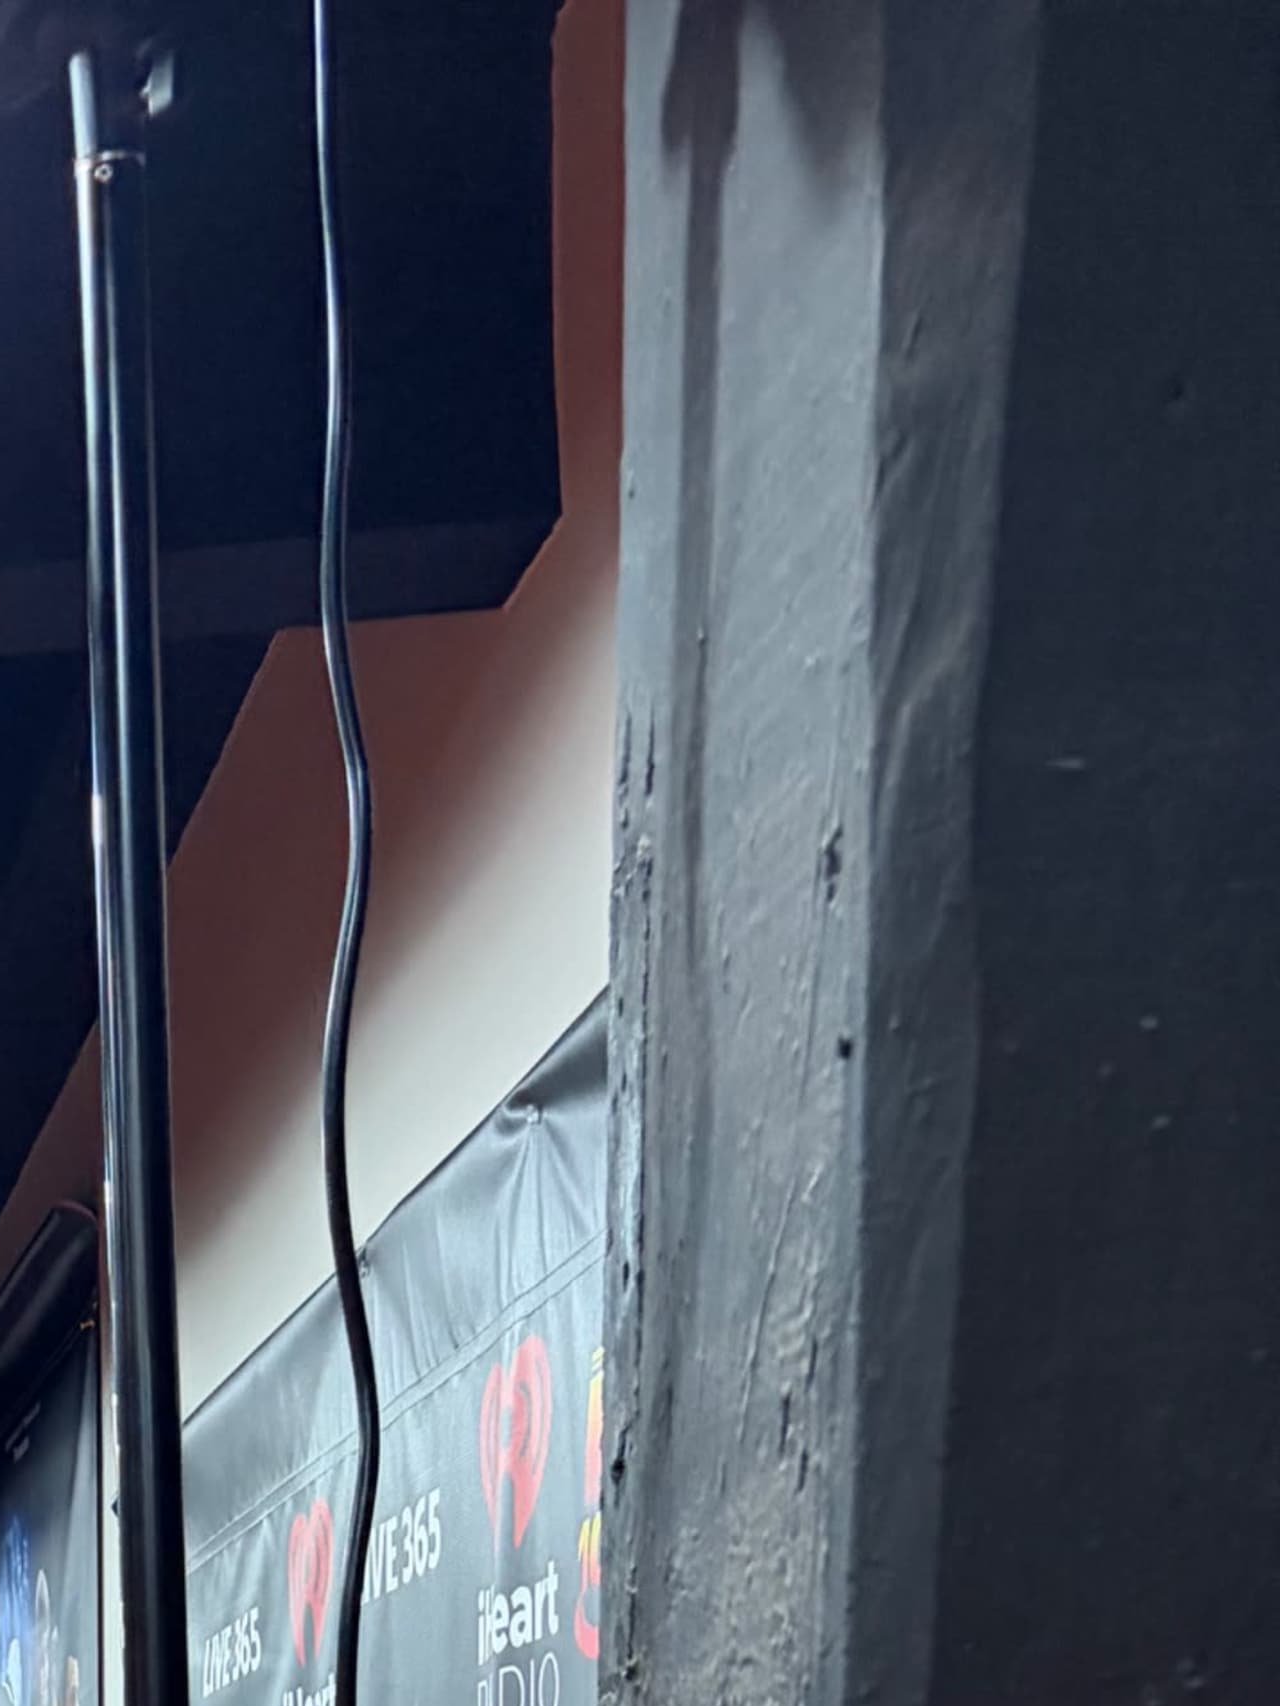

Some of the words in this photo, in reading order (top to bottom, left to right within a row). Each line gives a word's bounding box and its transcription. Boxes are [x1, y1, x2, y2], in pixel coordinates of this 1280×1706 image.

[359, 1508, 399, 1606] IVE
[401, 1487, 441, 1585] 365
[477, 1561, 560, 1667] ieart
